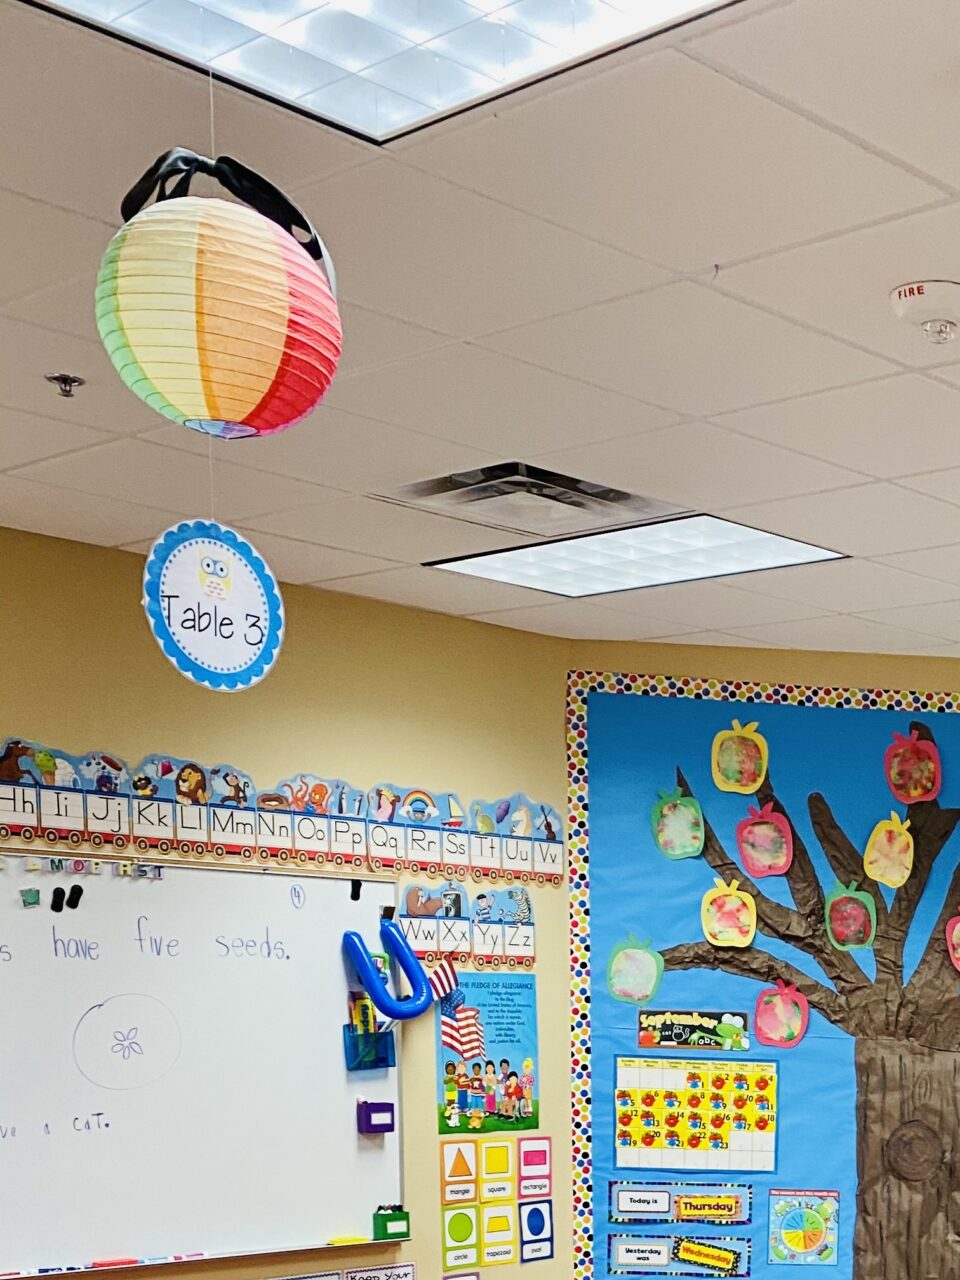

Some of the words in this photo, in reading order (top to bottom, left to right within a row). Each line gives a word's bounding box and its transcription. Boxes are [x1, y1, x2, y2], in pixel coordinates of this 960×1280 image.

[898, 285, 925, 299] FIRE
[160, 595, 234, 639] Table
[244, 613, 264, 646] 3
[54, 792, 68, 816] Ii
[92, 797, 122, 832] Jj
[138, 802, 168, 827] Kk
[181, 806, 201, 830] Ll
[213, 809, 253, 834] Mm
[258, 814, 289, 837] Nn
[298, 818, 325, 840] Oo
[335, 821, 362, 853] Pp
[372, 826, 403, 858] Qq
[411, 830, 436, 851] Rr
[447, 834, 465, 854] Ss
[475, 836, 495, 858] Tt
[505, 841, 528, 861] Uu
[539, 843, 557, 863] Vv
[53, 925, 99, 960] have
[134, 916, 179, 956] five
[400, 920, 435, 940] Ww
[443, 921, 468, 942] Xx
[477, 925, 498, 954] Yy
[508, 926, 530, 946] Zz
[683, 1201, 733, 1212] Thursday
[625, 1247, 661, 1256] Yesterday
[682, 1246, 731, 1265] Wednesday
